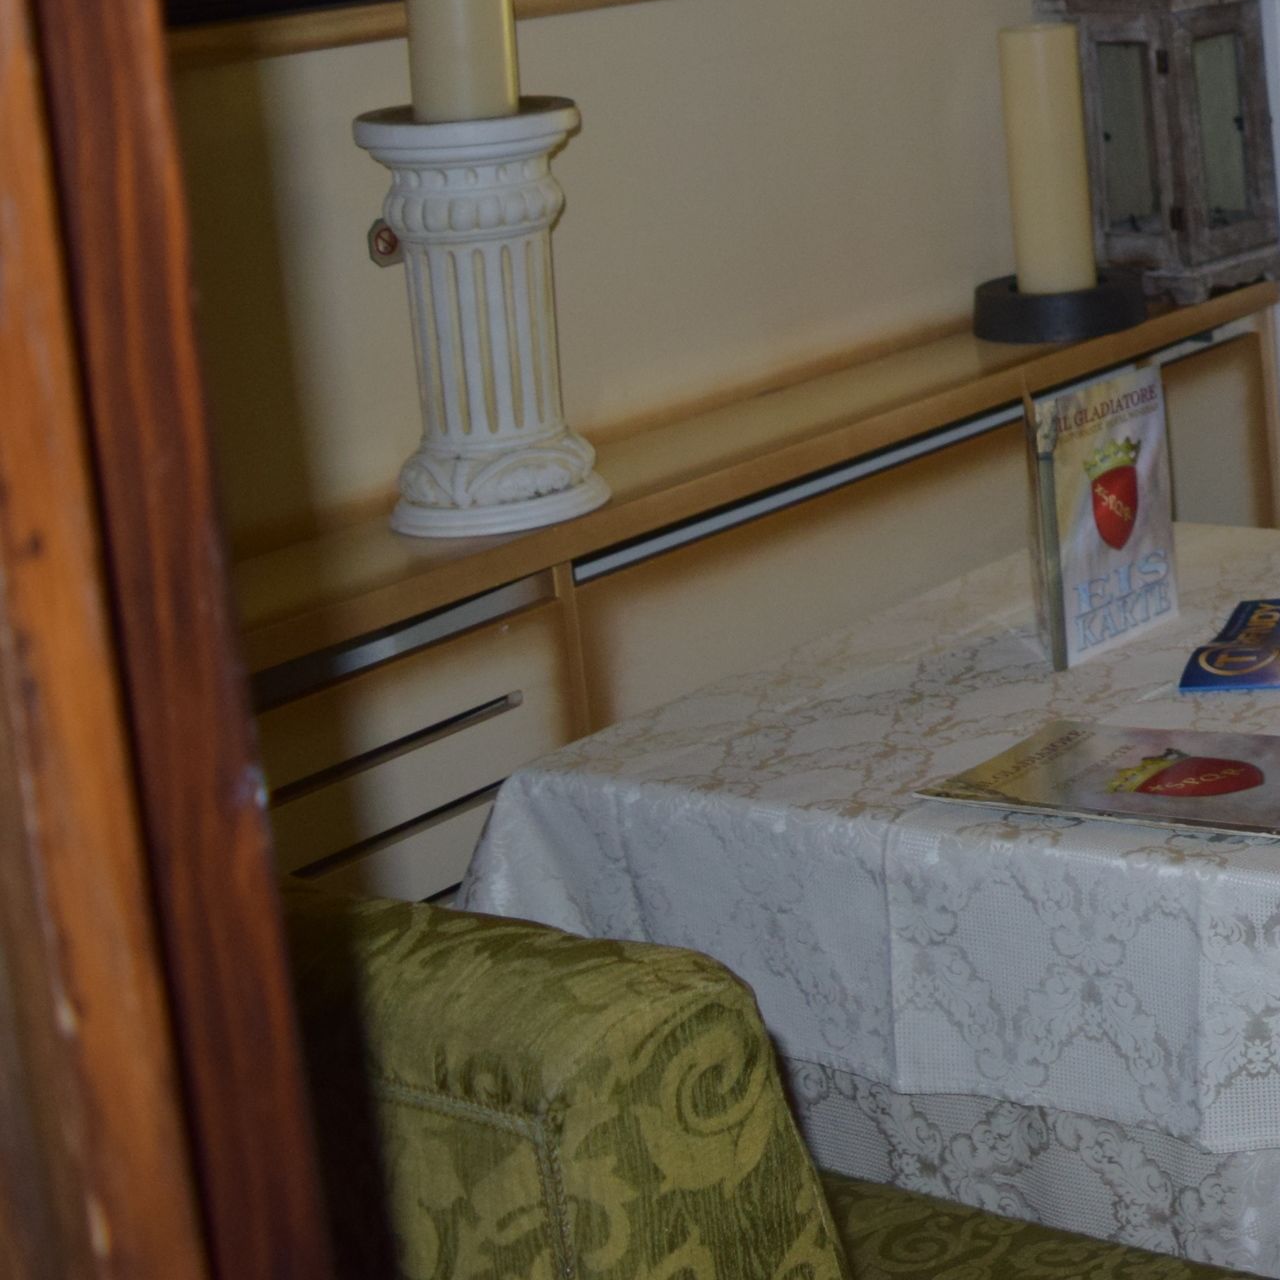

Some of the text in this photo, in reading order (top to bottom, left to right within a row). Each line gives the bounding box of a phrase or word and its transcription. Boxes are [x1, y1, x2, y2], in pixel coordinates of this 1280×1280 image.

[1074, 384, 1157, 427] GLADIATORE
[1073, 548, 1169, 618] EIS
[1074, 582, 1171, 652] KARTE
